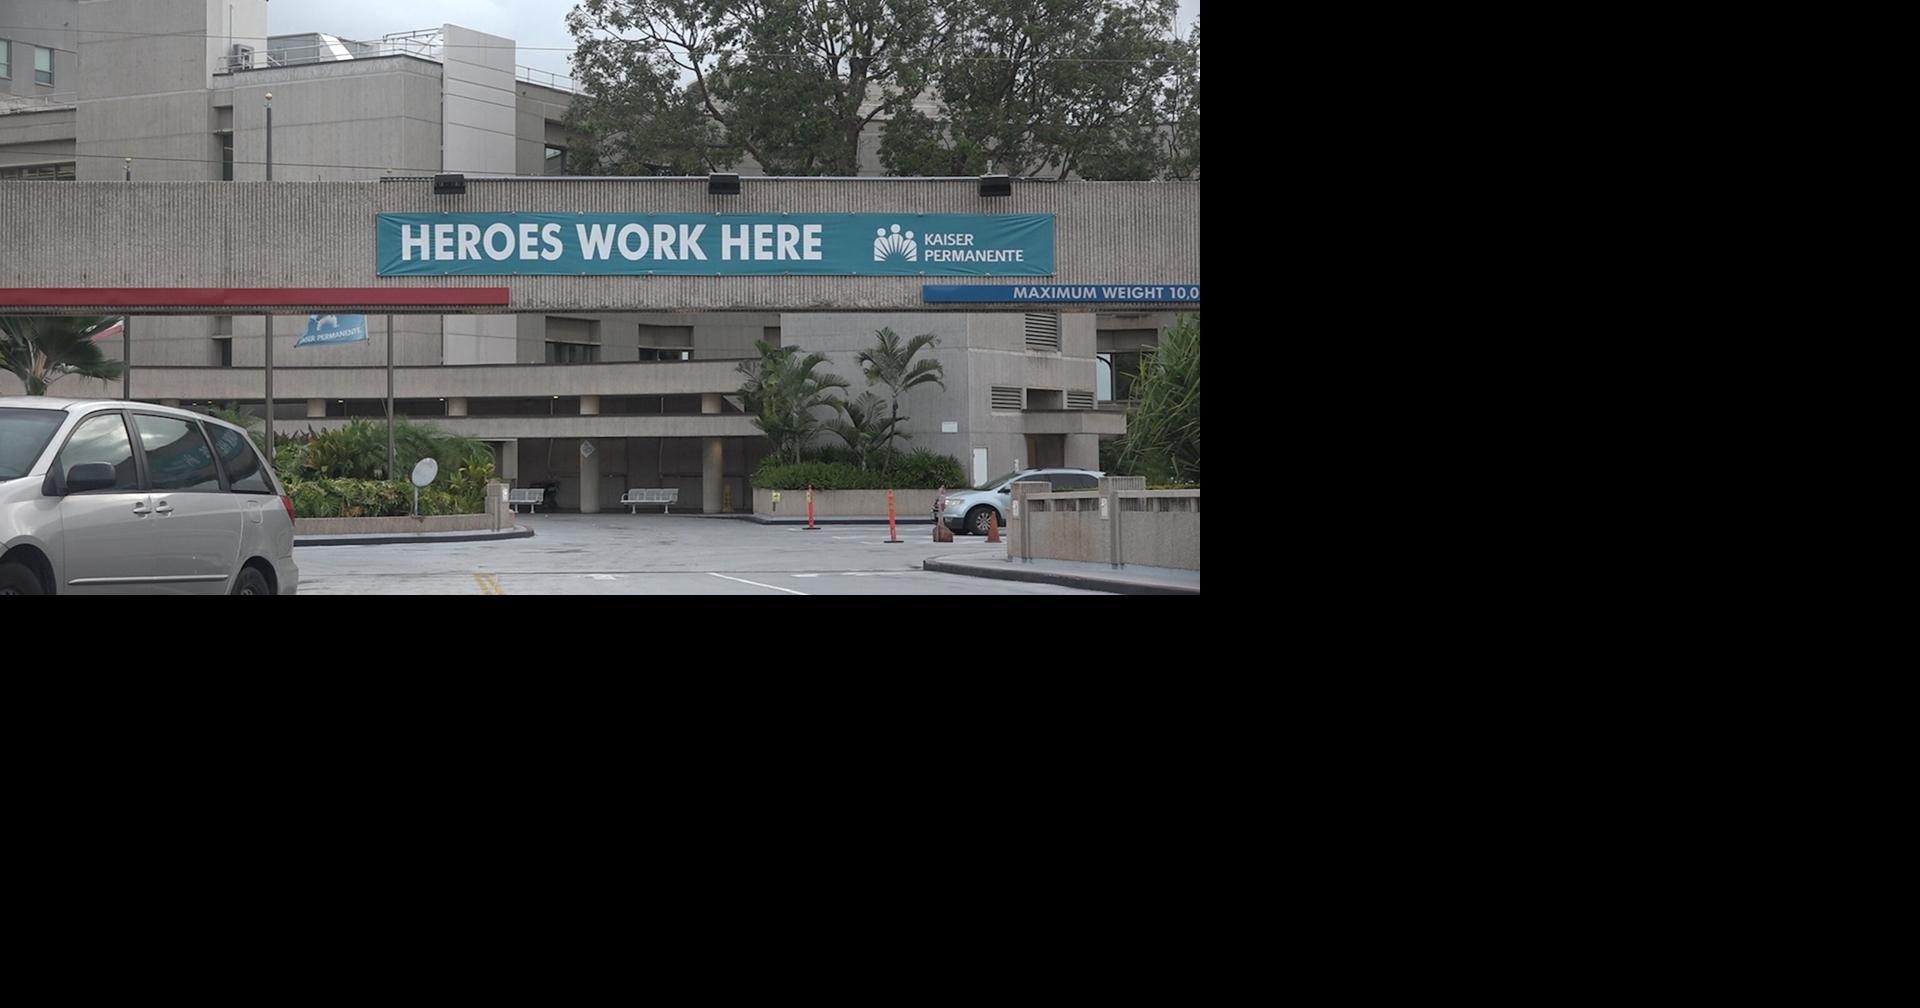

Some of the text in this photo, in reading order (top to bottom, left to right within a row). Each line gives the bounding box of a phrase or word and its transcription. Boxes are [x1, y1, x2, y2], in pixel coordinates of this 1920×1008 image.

[401, 222, 822, 261] HEROES WORK HERE
[924, 233, 974, 246] KAISER
[924, 249, 1024, 262] PERMANENTE
[1013, 287, 1200, 300] MAXIMUM WEIGHT 10,0
